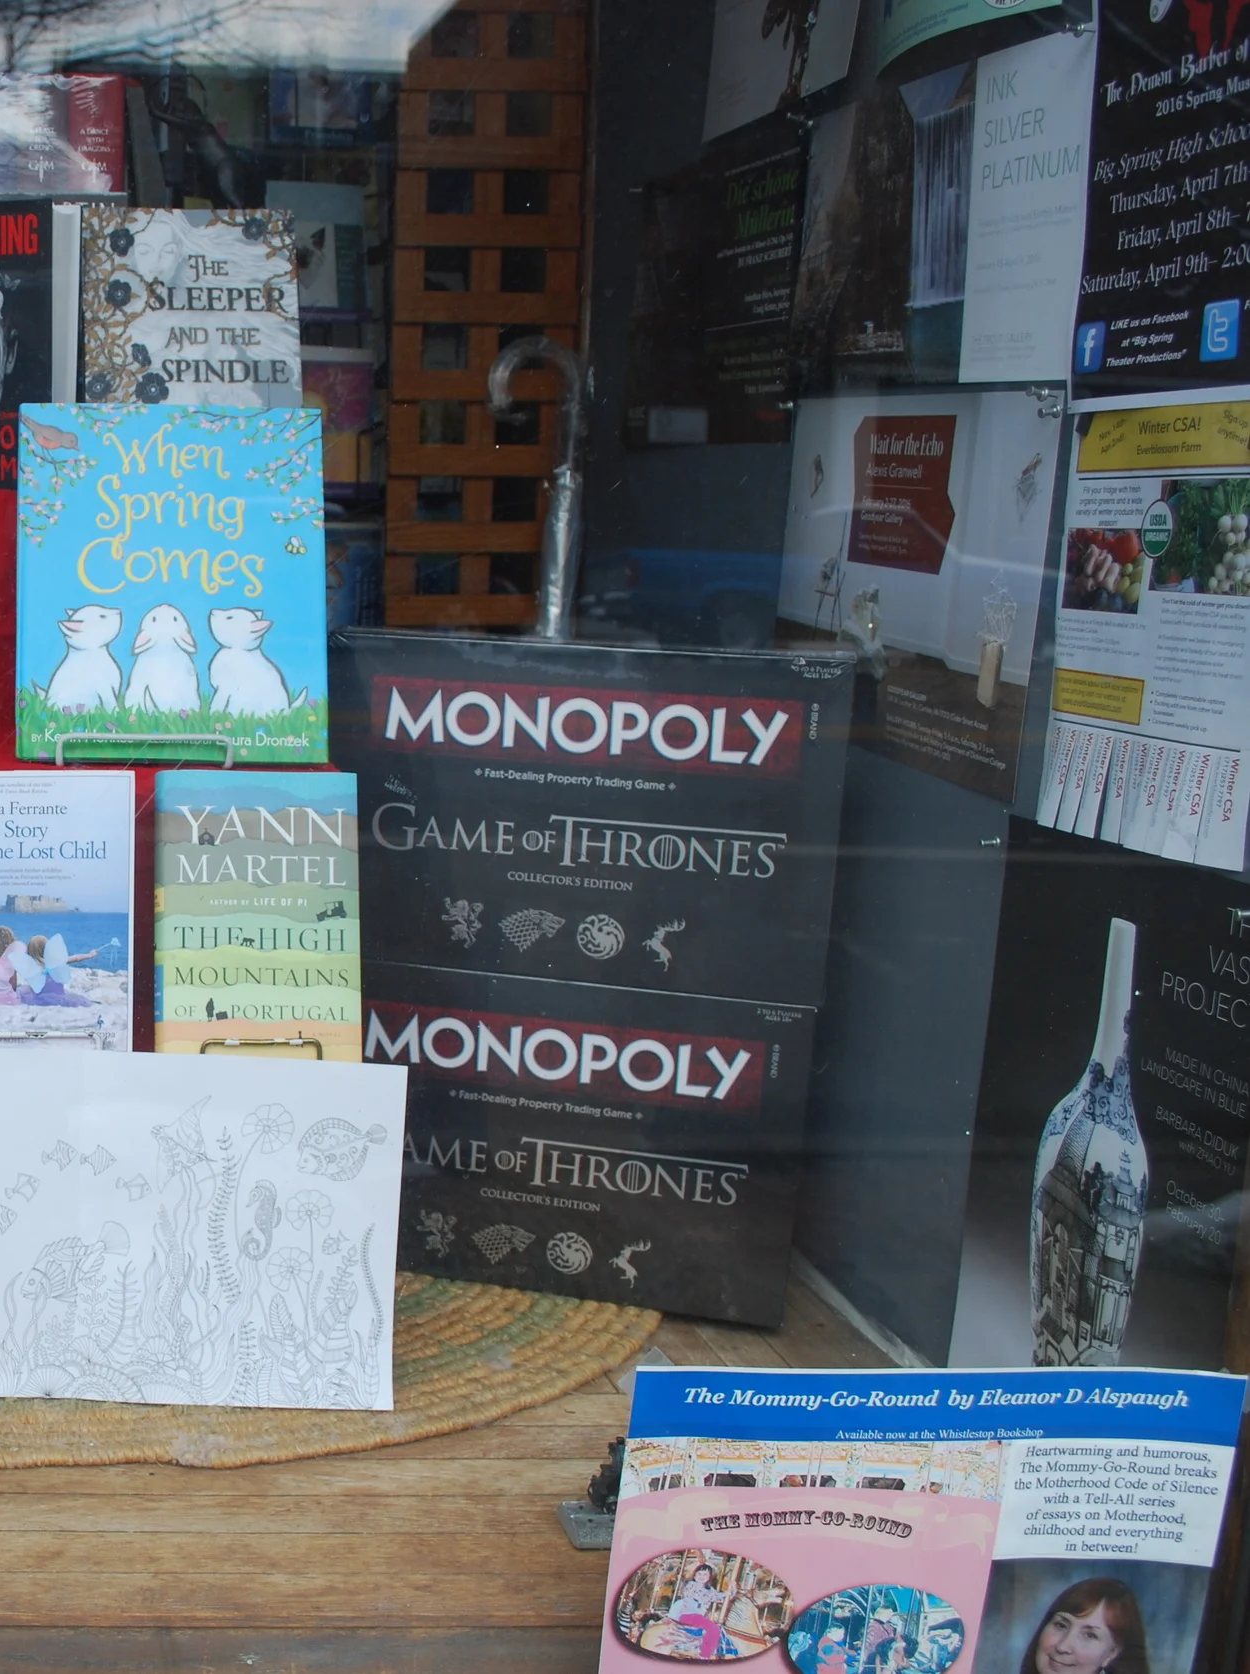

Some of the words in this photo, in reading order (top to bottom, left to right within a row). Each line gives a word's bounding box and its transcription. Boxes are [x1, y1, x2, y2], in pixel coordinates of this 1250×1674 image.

[986, 69, 1018, 104] INK
[1100, 79, 1122, 107] The
[1126, 68, 1172, 103] Demon
[1180, 41, 1231, 85] Barber
[1155, 95, 1183, 117] 2016
[1186, 86, 1223, 110] Spring
[983, 107, 1045, 148] SILVER
[981, 144, 1080, 192] PLATINUM
[1094, 159, 1115, 184] Big
[1117, 147, 1163, 180] Spring
[1166, 132, 1203, 164] High
[1110, 183, 1177, 214] Thursday,
[1180, 167, 1218, 200] April
[1117, 225, 1162, 250] Friday,
[1165, 212, 1202, 244] April
[1081, 268, 1141, 295] Saturday,
[1145, 256, 1181, 287] April
[147, 280, 289, 313] SLEEPER
[1110, 319, 1129, 331] LIKE
[1151, 310, 1189, 325] Facebook
[165, 326, 209, 352] AND
[216, 327, 261, 346] THE
[1148, 333, 1174, 346] Spring
[161, 359, 290, 384] SPINDLE
[1105, 357, 1135, 368] Theater
[1138, 420, 1171, 435] Winter
[1172, 416, 1201, 433] CSA!
[102, 424, 231, 480] When
[870, 433, 889, 455] Wait
[889, 433, 904, 456] for
[904, 432, 920, 456] the
[920, 432, 944, 457] Echo
[1136, 444, 1179, 456] Everblossom
[1180, 443, 1202, 453] Farm
[866, 463, 888, 477] Alexis
[889, 462, 923, 479] Granwell
[95, 473, 247, 541] Spring
[76, 535, 266, 598] Comes
[384, 685, 789, 766] MONOPOLY
[256, 732, 310, 747] Dronzek
[484, 768, 544, 784] Fast-Dealing
[547, 772, 592, 787] Property
[595, 776, 632, 790] Trading
[634, 779, 665, 791] Game
[1225, 758, 1240, 798] Winter
[9, 801, 68, 815] Ferrante
[1221, 800, 1233, 822] CSA
[4, 820, 48, 842] Story
[174, 805, 347, 847] YANN
[18, 841, 55, 859] Lost
[60, 840, 107, 859] Child
[372, 801, 514, 855] GAME
[522, 829, 556, 853] OF
[549, 814, 788, 878] THRONES
[175, 854, 347, 886] MARTEL
[583, 877, 633, 891] EDITION
[253, 897, 277, 907] LIFE
[259, 926, 346, 951] HIGH
[174, 966, 349, 987] MOUNTAINS
[174, 1005, 197, 1017] OF
[231, 1004, 349, 1022] PORTUGAL
[364, 1008, 752, 1100] MONOPOLY
[1165, 1047, 1198, 1074] MADE
[1213, 1069, 1249, 1097] CHINA
[1140, 1056, 1202, 1097] LANDSCAPE
[1218, 1093, 1247, 1118] BLUE
[459, 1089, 517, 1107] Fast-Dealing
[518, 1097, 563, 1113] Property
[565, 1102, 601, 1117] Trading
[603, 1107, 633, 1120] Game
[1155, 1106, 1201, 1139] BARBARA
[1204, 1131, 1239, 1160] DIDUK
[494, 1150, 528, 1173] OF
[520, 1136, 749, 1206] THRONES
[553, 1197, 601, 1213] EDITION
[1166, 1180, 1206, 1213] October
[684, 1387, 726, 1404] The
[728, 1388, 940, 1411] Mommy-Go-Round
[948, 1389, 975, 1410] by
[978, 1388, 1061, 1406] Eleanor
[1064, 1388, 1083, 1404] D
[1085, 1387, 1189, 1410] Alspaugh
[835, 1429, 884, 1440] Available
[885, 1431, 907, 1440] now
[909, 1430, 919, 1439] at
[920, 1429, 936, 1439] the
[939, 1428, 995, 1441] Whistlestop
[997, 1428, 1044, 1439] Bookshop
[1025, 1446, 1113, 1459] Heartwarming
[1116, 1446, 1139, 1458] and
[1142, 1446, 1212, 1464] humorous,
[1020, 1462, 1043, 1473] The
[1045, 1461, 1171, 1477] Mommy-Go-Round
[1174, 1465, 1218, 1479] breaks
[1014, 1478, 1032, 1490] the
[1035, 1477, 1111, 1489] Motherhood
[1114, 1477, 1148, 1490] Code
[1151, 1479, 1167, 1491] of
[1169, 1480, 1219, 1496] Silence
[1043, 1493, 1069, 1505] with
[1072, 1496, 1080, 1505] a
[1084, 1493, 1135, 1506] Tell-All
[1138, 1497, 1176, 1508] series
[700, 1513, 741, 1532] THE
[744, 1510, 913, 1539] MOMMY-GO-ROUND
[1026, 1509, 1042, 1521] of
[1042, 1511, 1081, 1523] essays
[1085, 1512, 1100, 1520] on
[1104, 1509, 1187, 1526] Motherhood,
[1023, 1523, 1085, 1536] childhood
[1088, 1524, 1111, 1536] and
[1115, 1526, 1184, 1543] everything
[1064, 1540, 1077, 1552] in
[1081, 1541, 1139, 1554] between!
